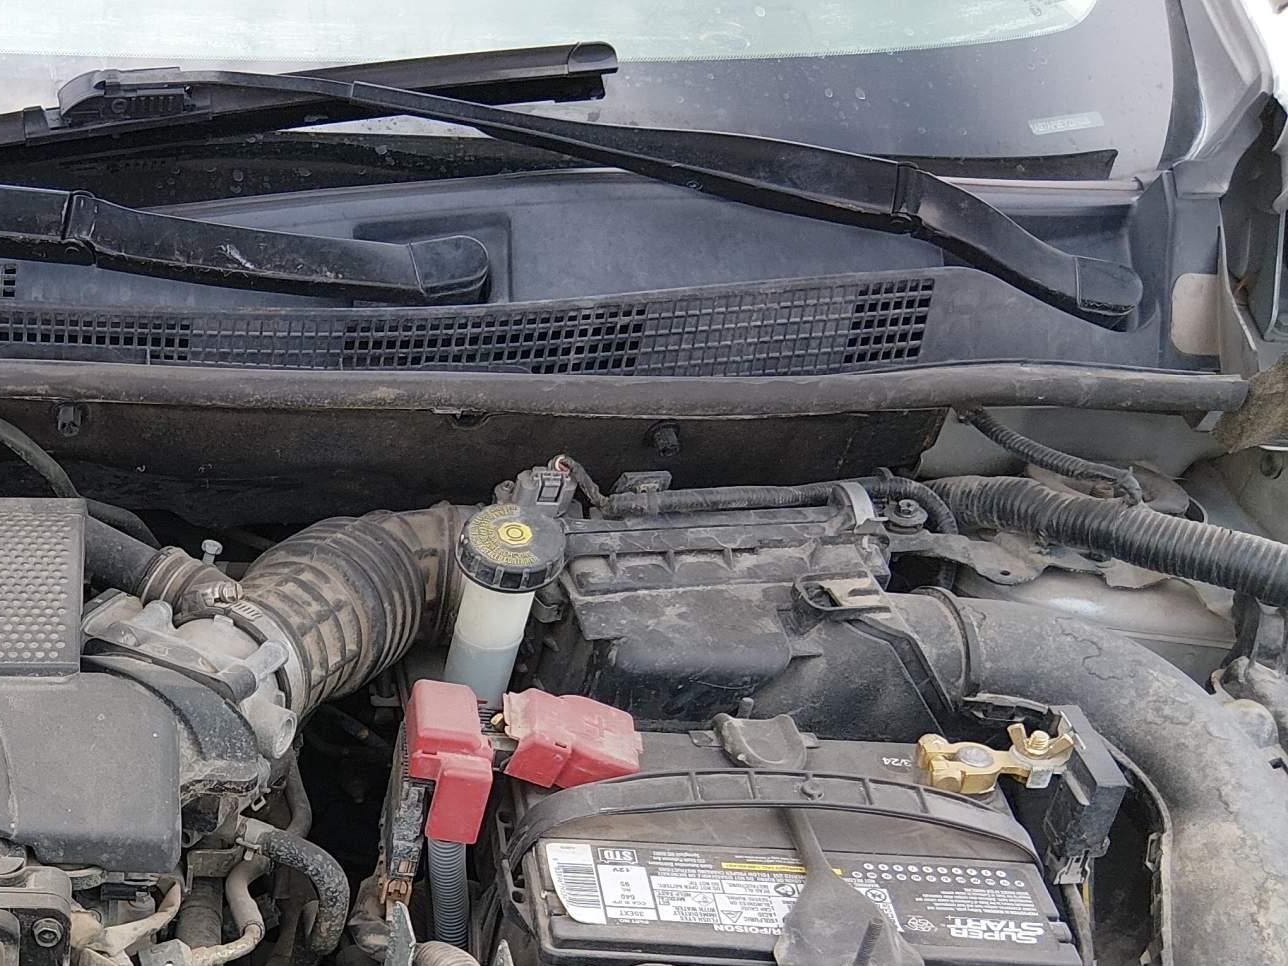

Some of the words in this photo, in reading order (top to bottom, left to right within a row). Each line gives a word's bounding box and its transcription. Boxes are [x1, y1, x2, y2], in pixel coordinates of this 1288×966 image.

[882, 757, 912, 767] 3/24
[603, 850, 633, 861] STD
[713, 924, 781, 935] R/POISON
[947, 917, 1044, 935] START
[950, 928, 1038, 944] SUPER
